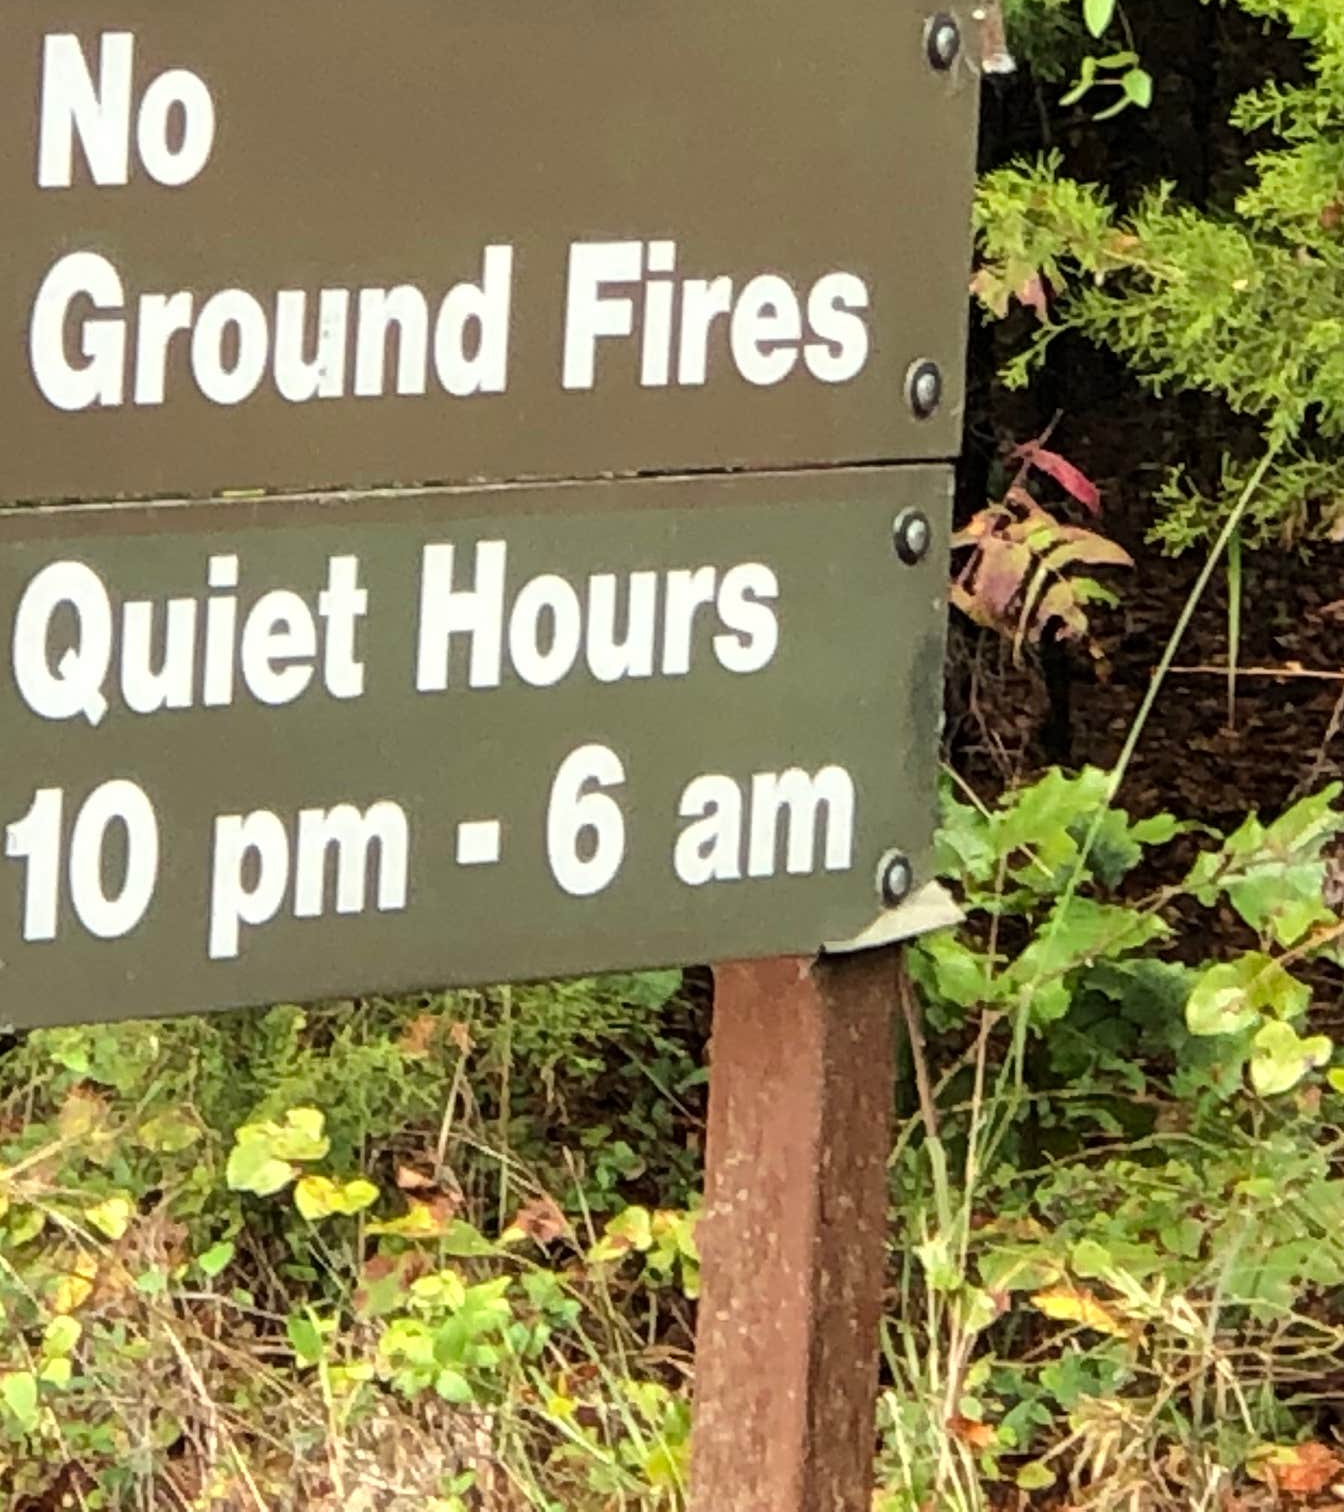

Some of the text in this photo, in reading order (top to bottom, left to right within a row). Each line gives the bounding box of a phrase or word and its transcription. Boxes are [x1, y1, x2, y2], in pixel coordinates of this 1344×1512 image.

[37, 31, 216, 190] No
[29, 239, 870, 412] Ground Fires
[12, 539, 780, 727] Quiet Hours
[4, 743, 856, 960] 10 pm - 6 am
